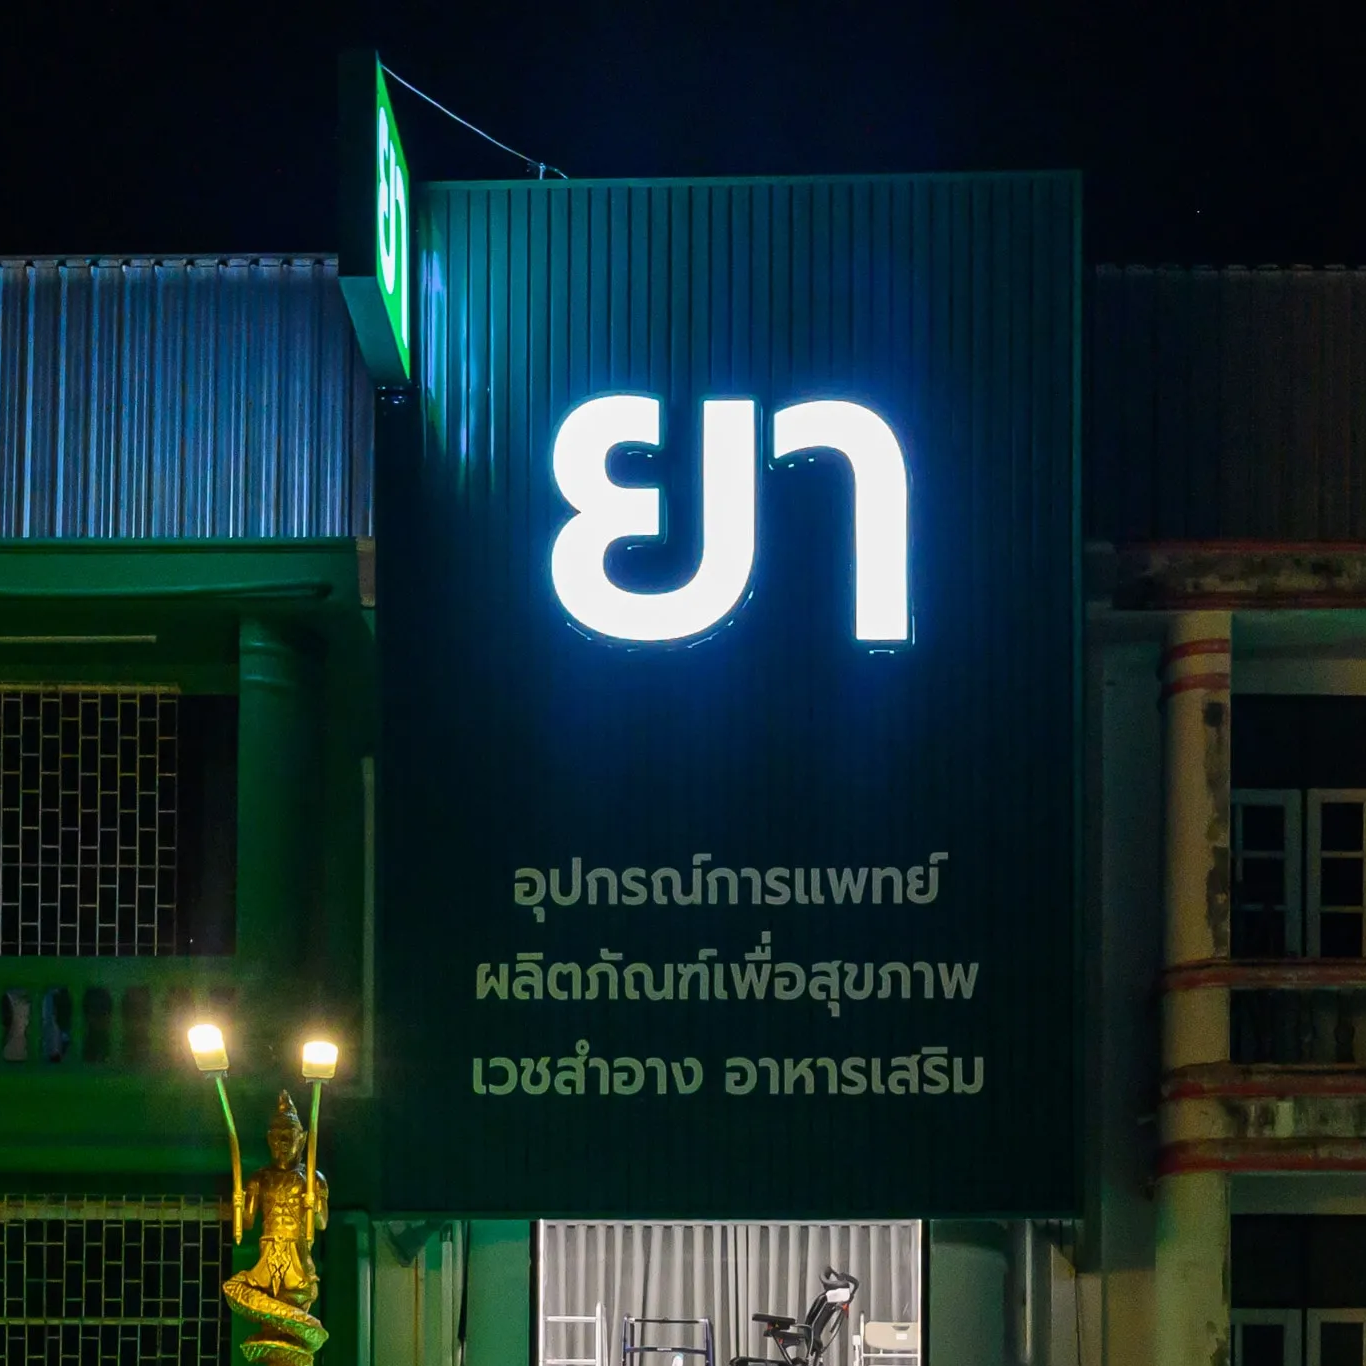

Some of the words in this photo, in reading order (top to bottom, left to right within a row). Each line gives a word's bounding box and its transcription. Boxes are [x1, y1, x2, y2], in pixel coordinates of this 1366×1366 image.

[378, 107, 408, 349] ยา
[550, 392, 913, 647] ยา
[513, 853, 949, 923] อุปกรณ์การแพทย์
[475, 931, 979, 1018] ผลิตภัณฑ์เพื่อสุขภาพ
[472, 1040, 704, 1097] เวชสำอาง
[724, 1045, 986, 1097] อาหารเสริม
